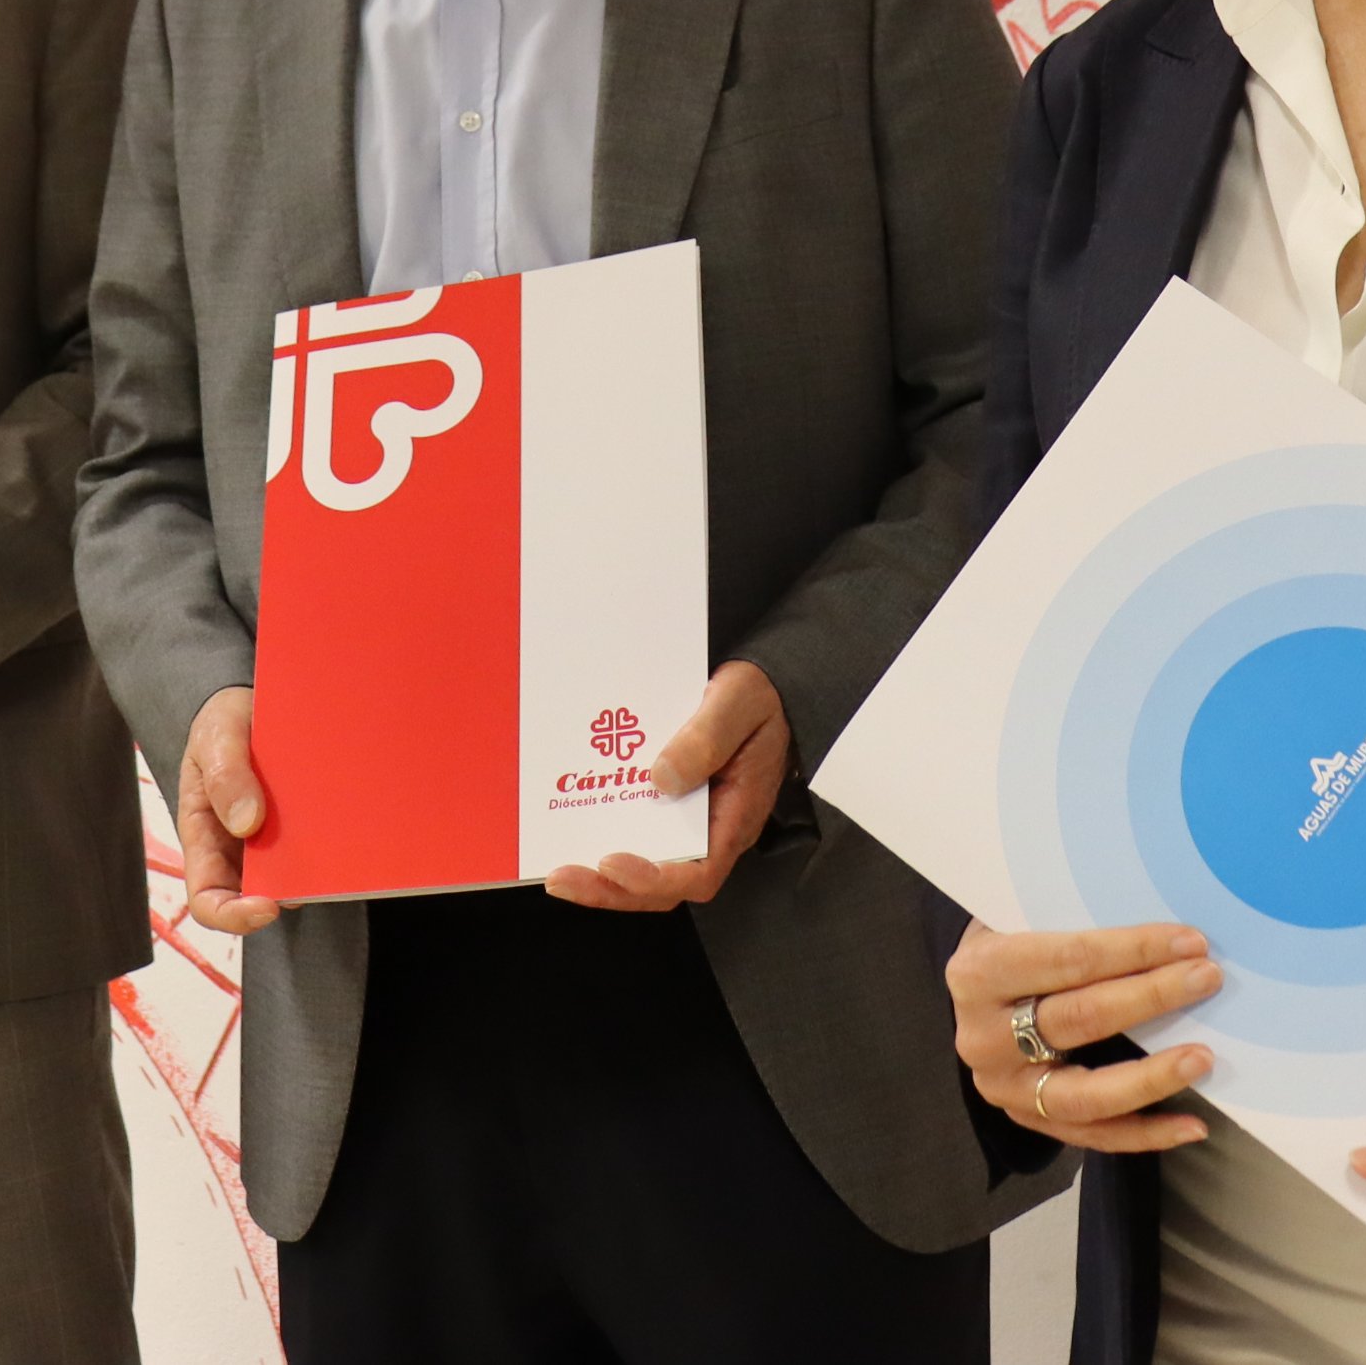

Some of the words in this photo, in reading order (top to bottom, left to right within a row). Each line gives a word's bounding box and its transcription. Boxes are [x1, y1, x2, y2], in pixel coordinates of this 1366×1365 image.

[555, 765, 653, 793] Cárita
[548, 792, 598, 810] Diócesis
[601, 790, 616, 804] de
[619, 786, 667, 802] Cartag
[1297, 790, 1339, 843] AGUAS
[1330, 772, 1353, 795] DE
